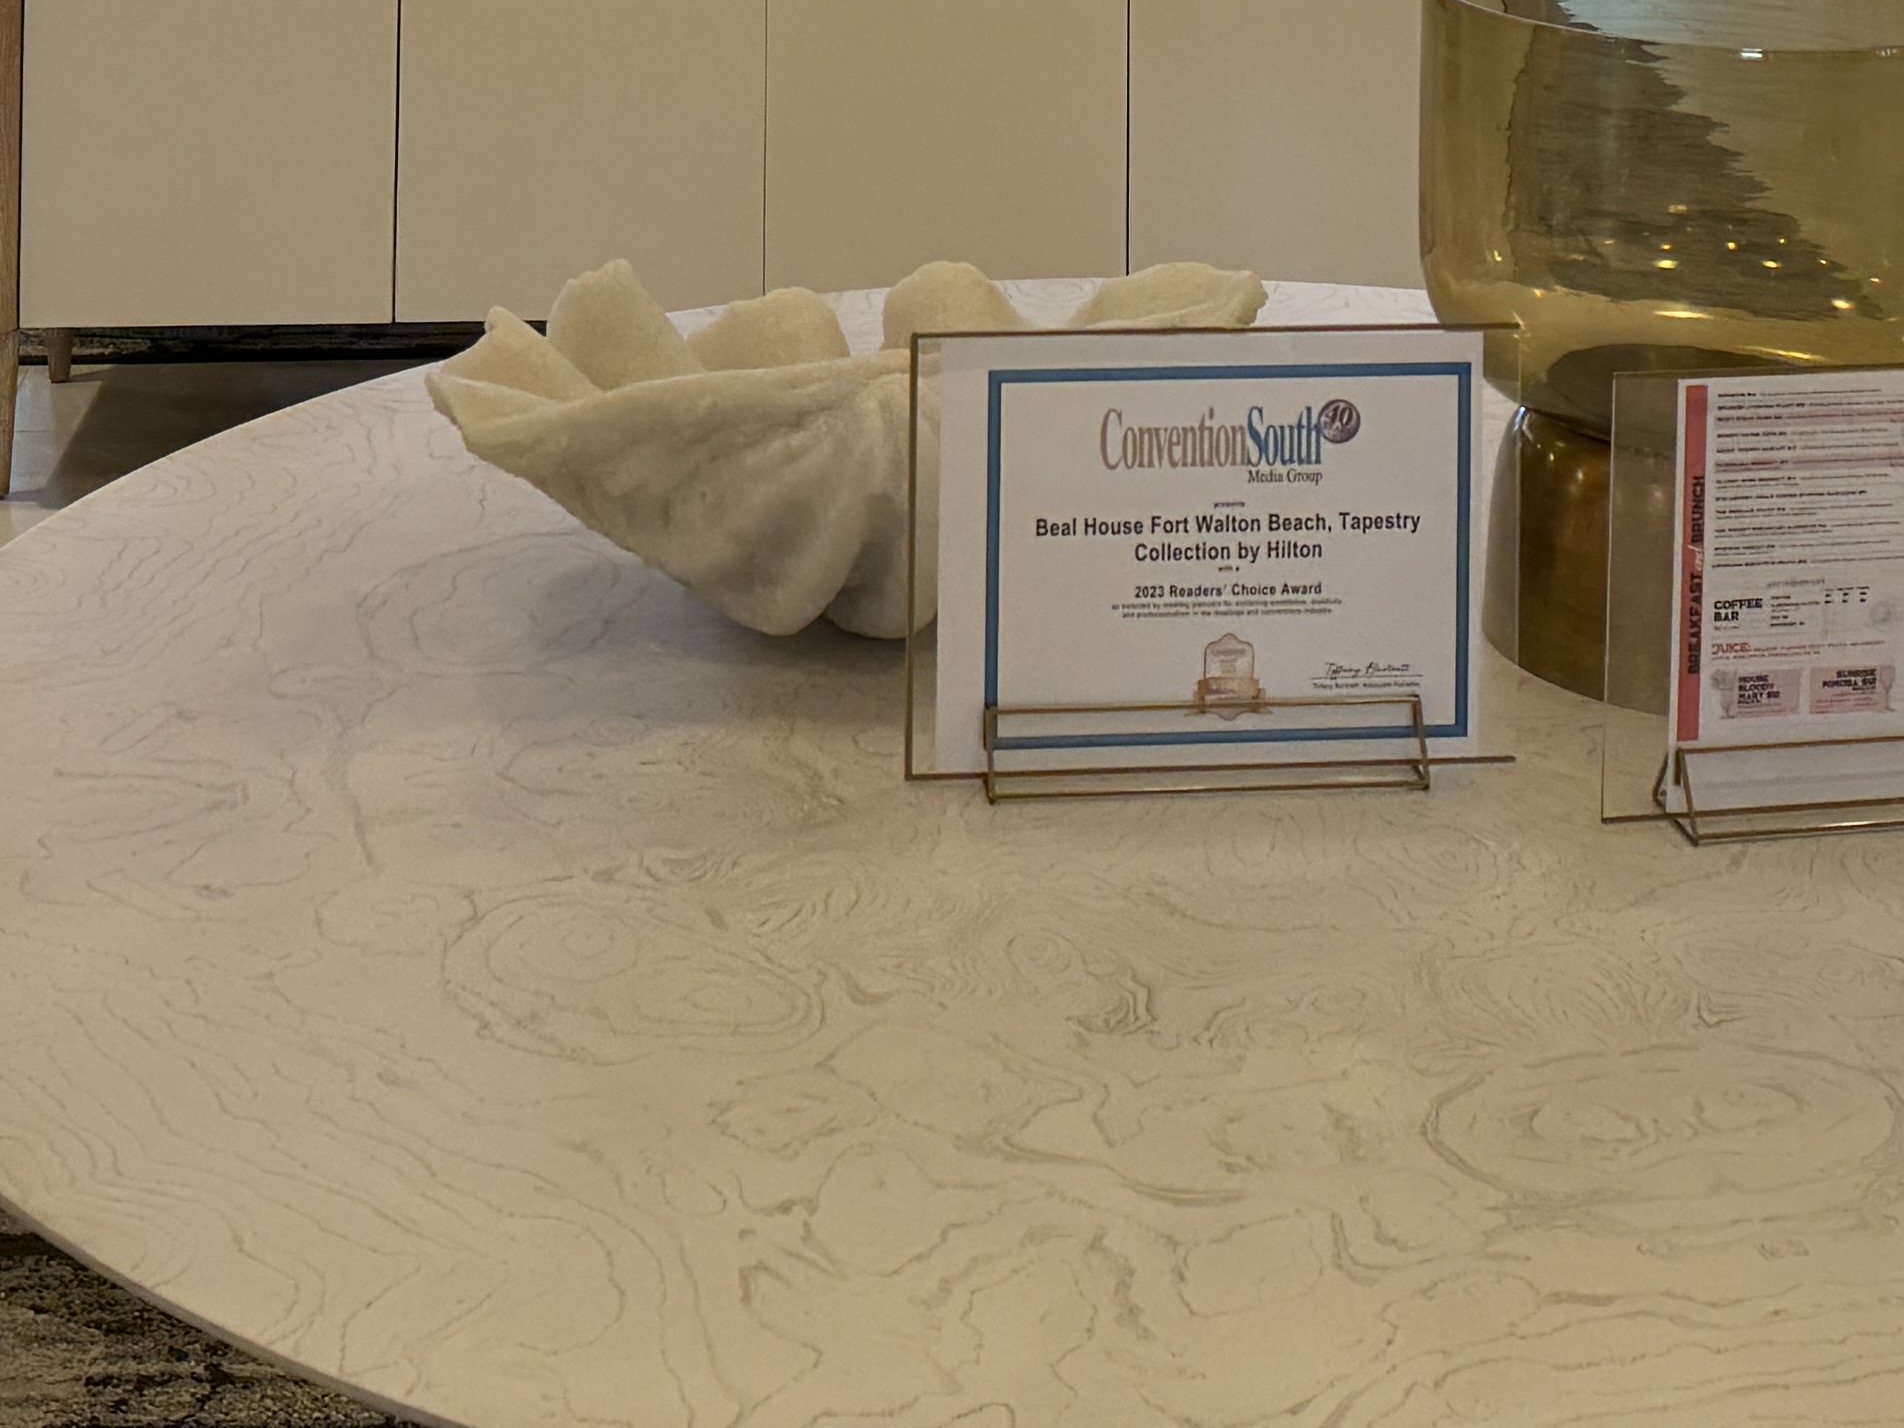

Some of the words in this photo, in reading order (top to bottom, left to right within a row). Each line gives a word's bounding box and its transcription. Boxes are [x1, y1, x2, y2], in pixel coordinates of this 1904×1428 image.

[1100, 405, 1322, 471] ConventionSouth
[1247, 469, 1284, 484] Media
[1286, 468, 1323, 486] Group
[1691, 476, 1706, 543] BRUNCH
[1036, 518, 1077, 537] Beal
[1084, 517, 1144, 536] House
[1151, 516, 1189, 535] Fort
[1195, 514, 1261, 534] Walton
[1268, 513, 1332, 534] Beach,
[1339, 511, 1421, 534] Tapestry
[1135, 542, 1230, 562] Collection
[1238, 542, 1259, 564] by
[1267, 540, 1323, 559] Hilton
[1135, 585, 1165, 599] 2023
[1169, 584, 1228, 597] Readers'
[1231, 582, 1277, 596] Choice
[1281, 582, 1323, 595] Award
[1714, 598, 1763, 611] COFFEE
[1714, 611, 1739, 622] BAR
[1688, 573, 1703, 674] BREAKFAST
